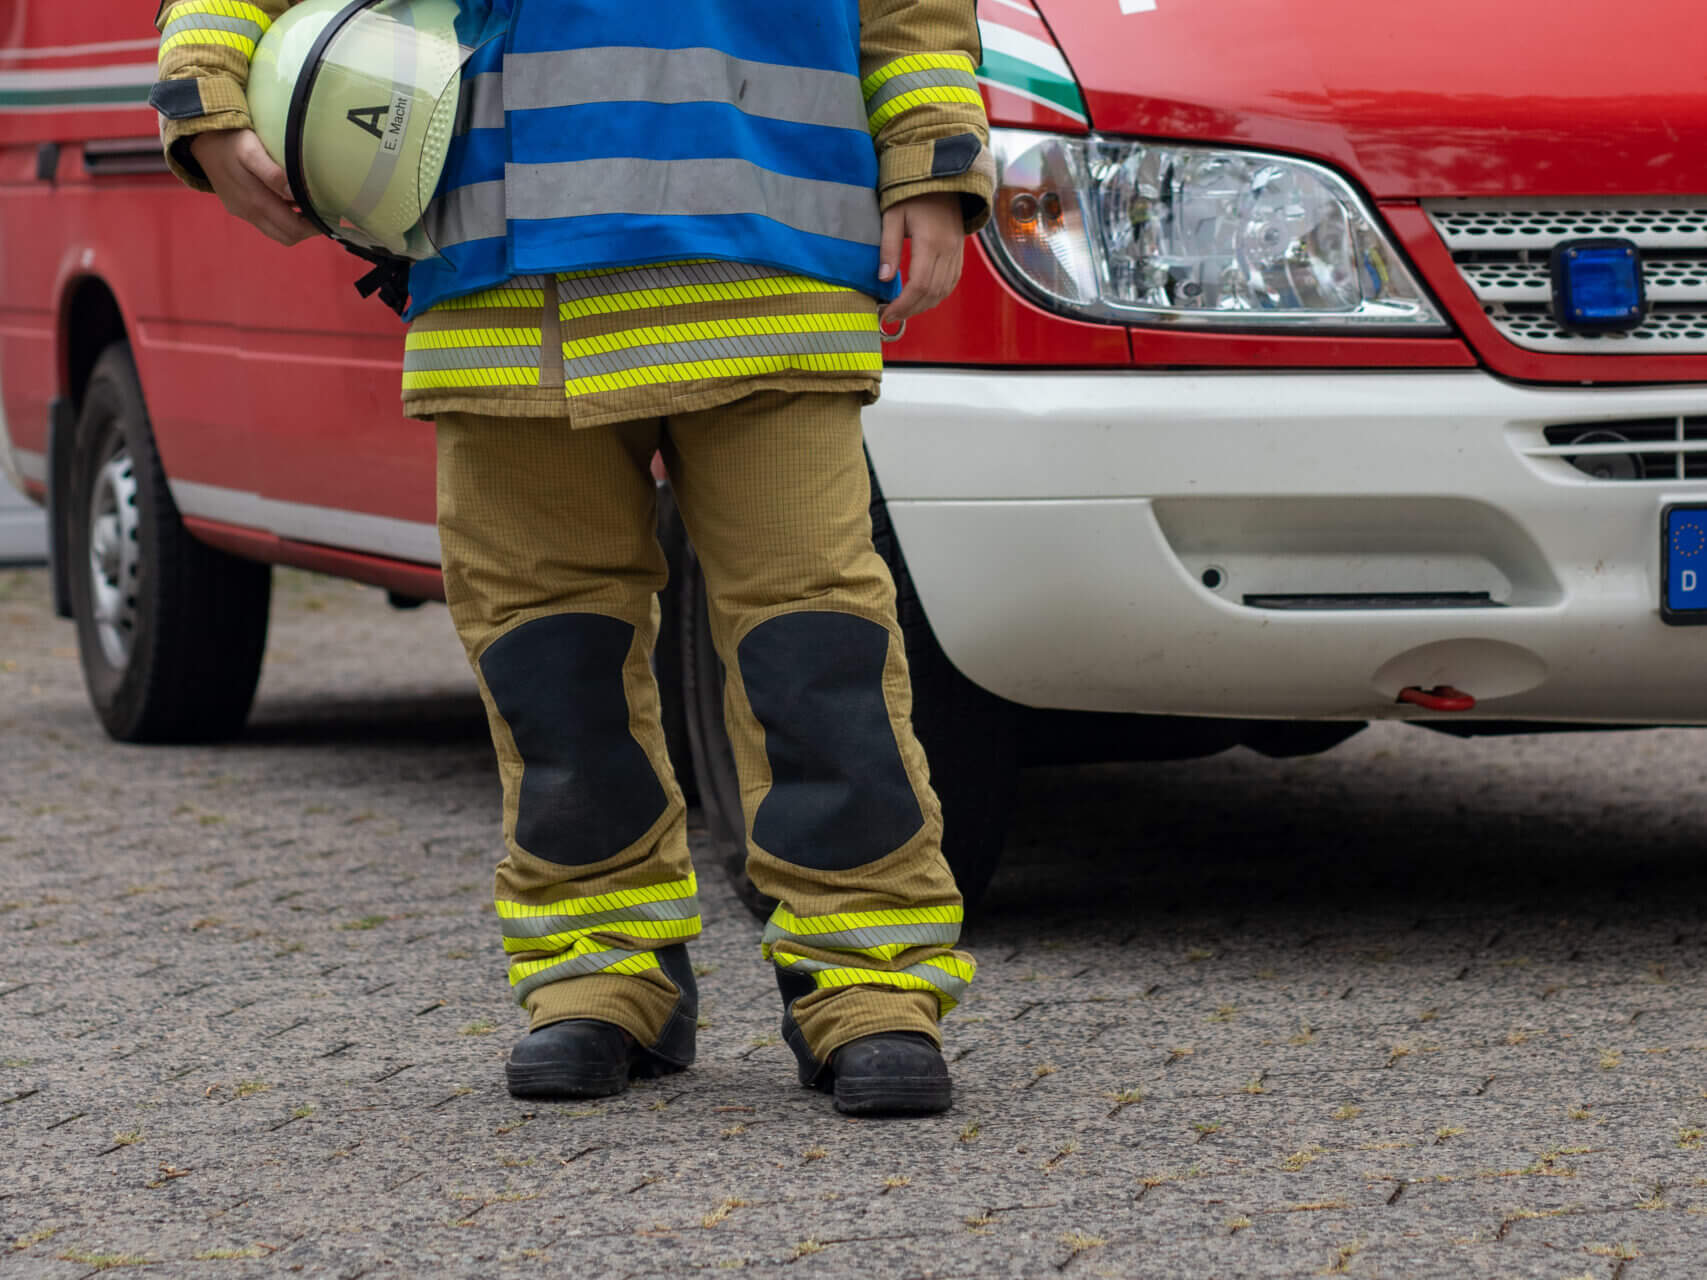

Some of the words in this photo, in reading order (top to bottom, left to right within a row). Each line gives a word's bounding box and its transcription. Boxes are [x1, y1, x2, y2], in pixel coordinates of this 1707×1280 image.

[346, 104, 391, 140] A
[388, 97, 408, 135] Macht
[383, 138, 398, 151] E.
[1681, 570, 1697, 591] D
